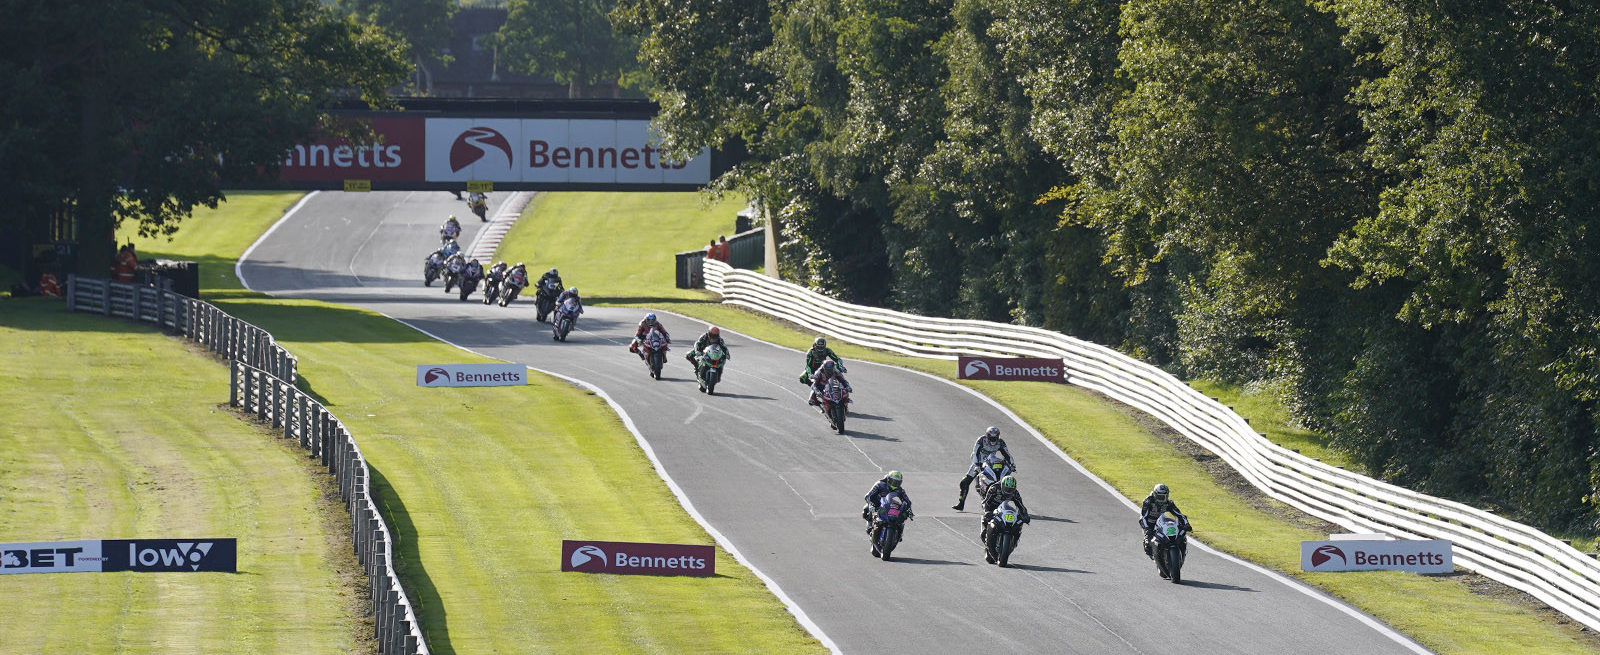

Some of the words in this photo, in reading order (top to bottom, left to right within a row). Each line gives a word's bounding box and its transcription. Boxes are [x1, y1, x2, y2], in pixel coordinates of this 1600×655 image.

[281, 141, 402, 168] nnetts
[456, 371, 520, 382] Bennetts
[995, 364, 1059, 377] Bennetts
[0, 547, 83, 569] BET
[615, 553, 706, 570] Bennetts
[1354, 550, 1444, 566] Bennetts
